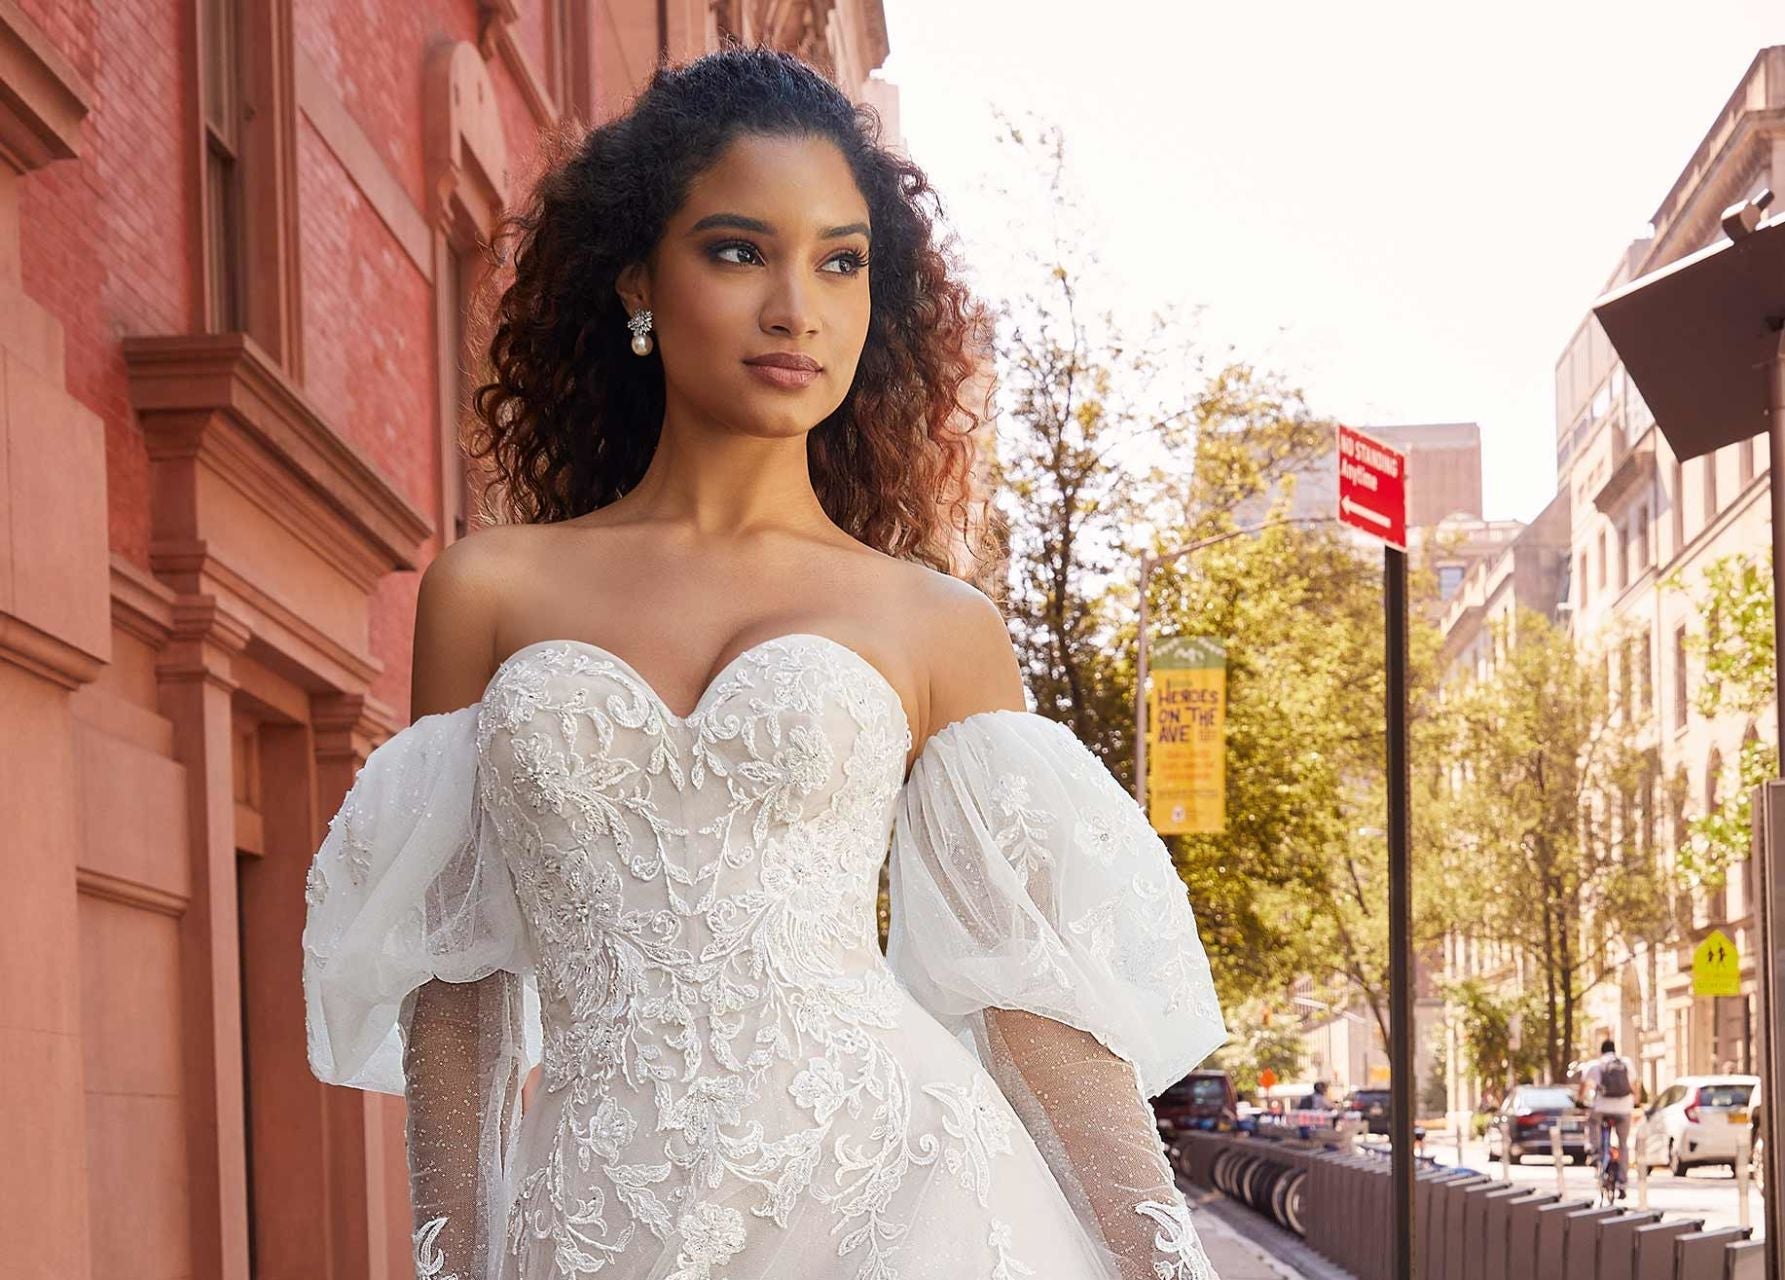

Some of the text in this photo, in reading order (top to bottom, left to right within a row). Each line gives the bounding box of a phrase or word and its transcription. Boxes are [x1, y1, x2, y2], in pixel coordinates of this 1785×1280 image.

[1355, 440, 1399, 478] STANDING
[1341, 458, 1378, 492] Anytime
[1157, 683, 1218, 705] HEROES
[1158, 706, 1217, 727] ON THE
[1159, 724, 1191, 743] AVE
